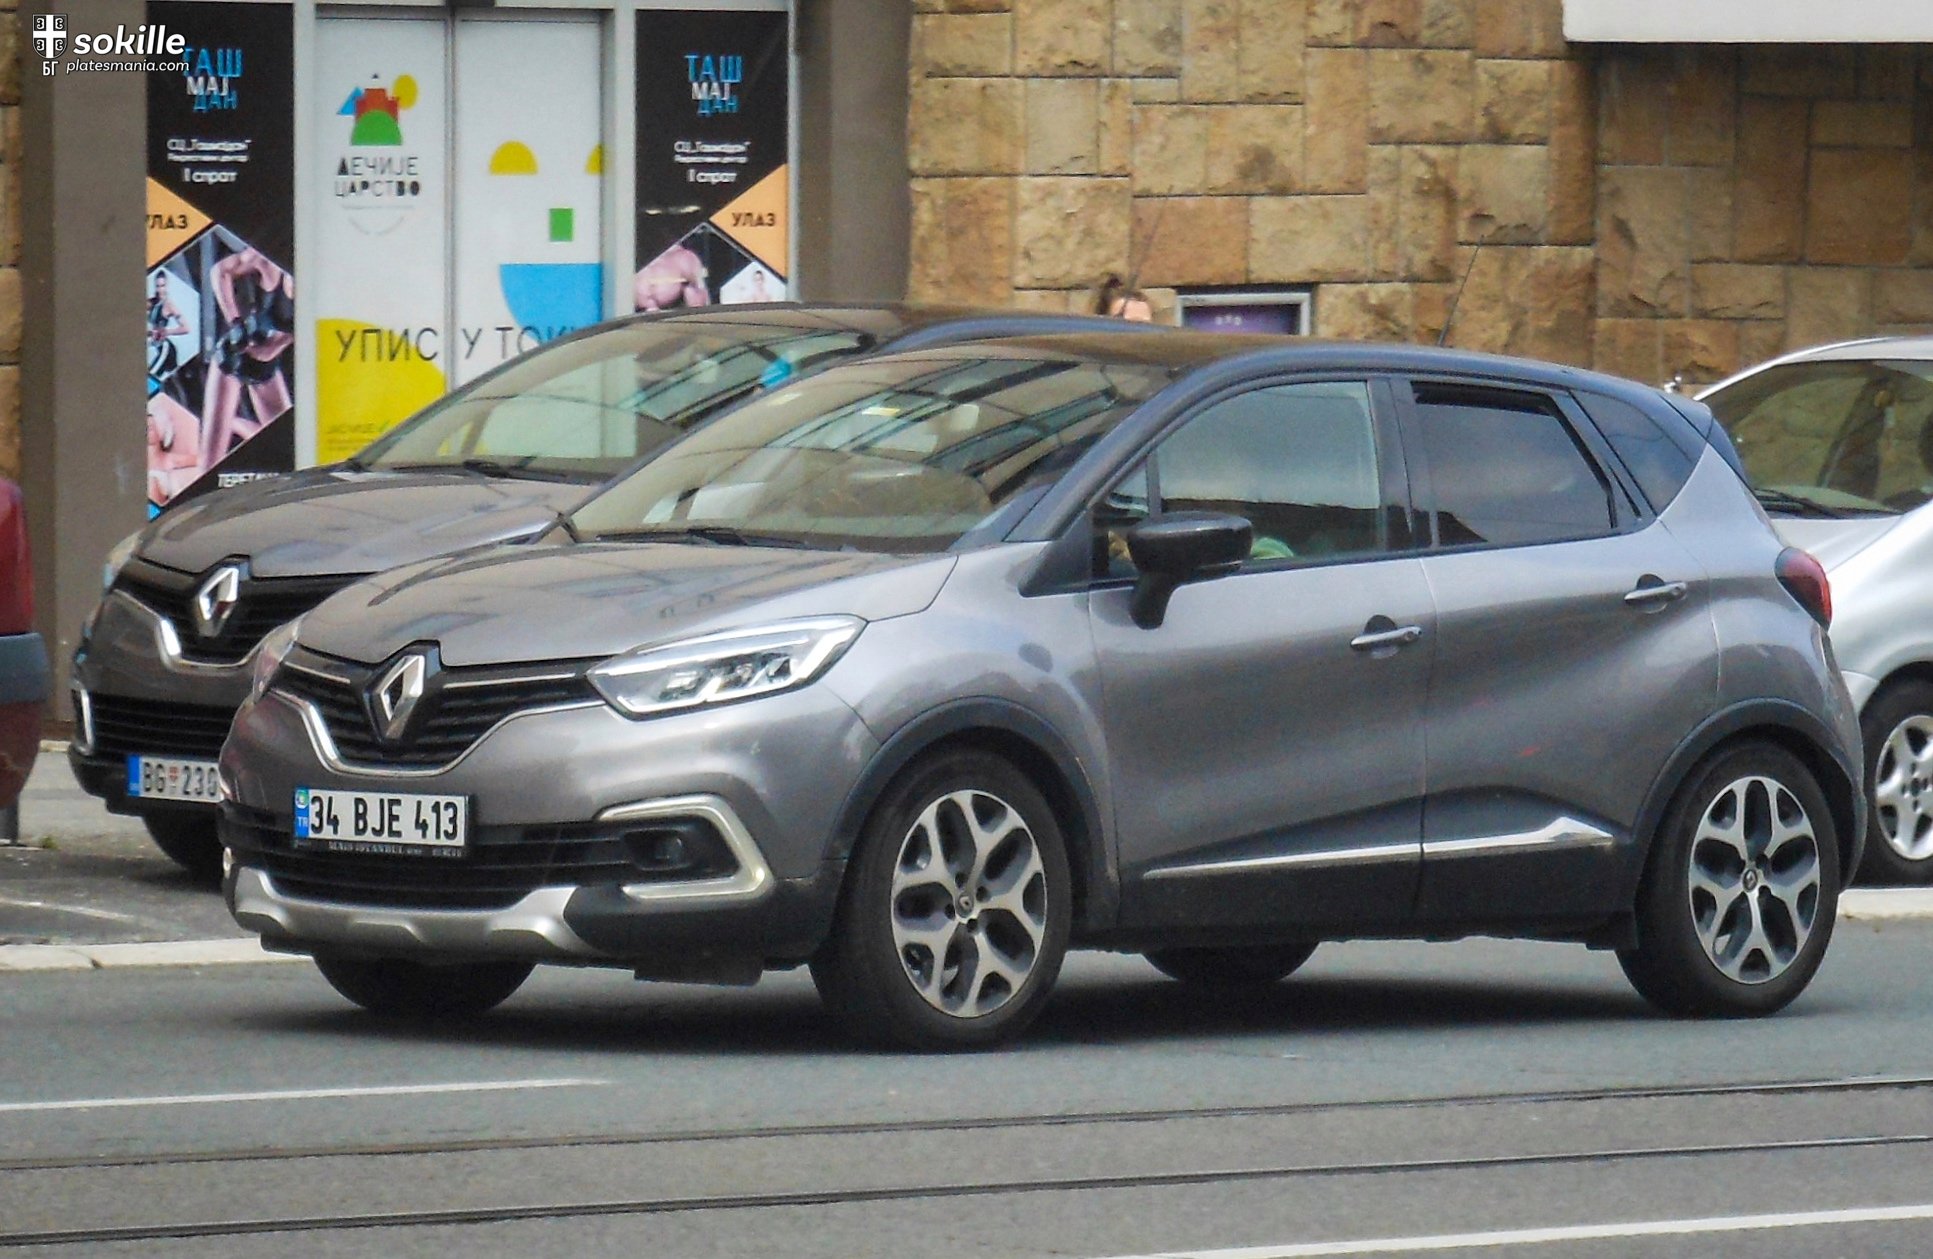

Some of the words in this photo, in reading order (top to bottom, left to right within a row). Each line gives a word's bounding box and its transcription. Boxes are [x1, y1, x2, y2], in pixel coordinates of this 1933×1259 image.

[684, 54, 743, 83] ТАШ
[336, 156, 419, 176] ДЕЧИЈЕ
[334, 180, 420, 197] ЦАРСТВО
[731, 212, 776, 227] УЛАЗ
[335, 327, 438, 362] УПИС
[462, 328, 483, 360] У
[143, 762, 166, 793] BG
[311, 795, 340, 835] 34
[354, 798, 403, 837] BJE
[414, 801, 459, 840] 413
